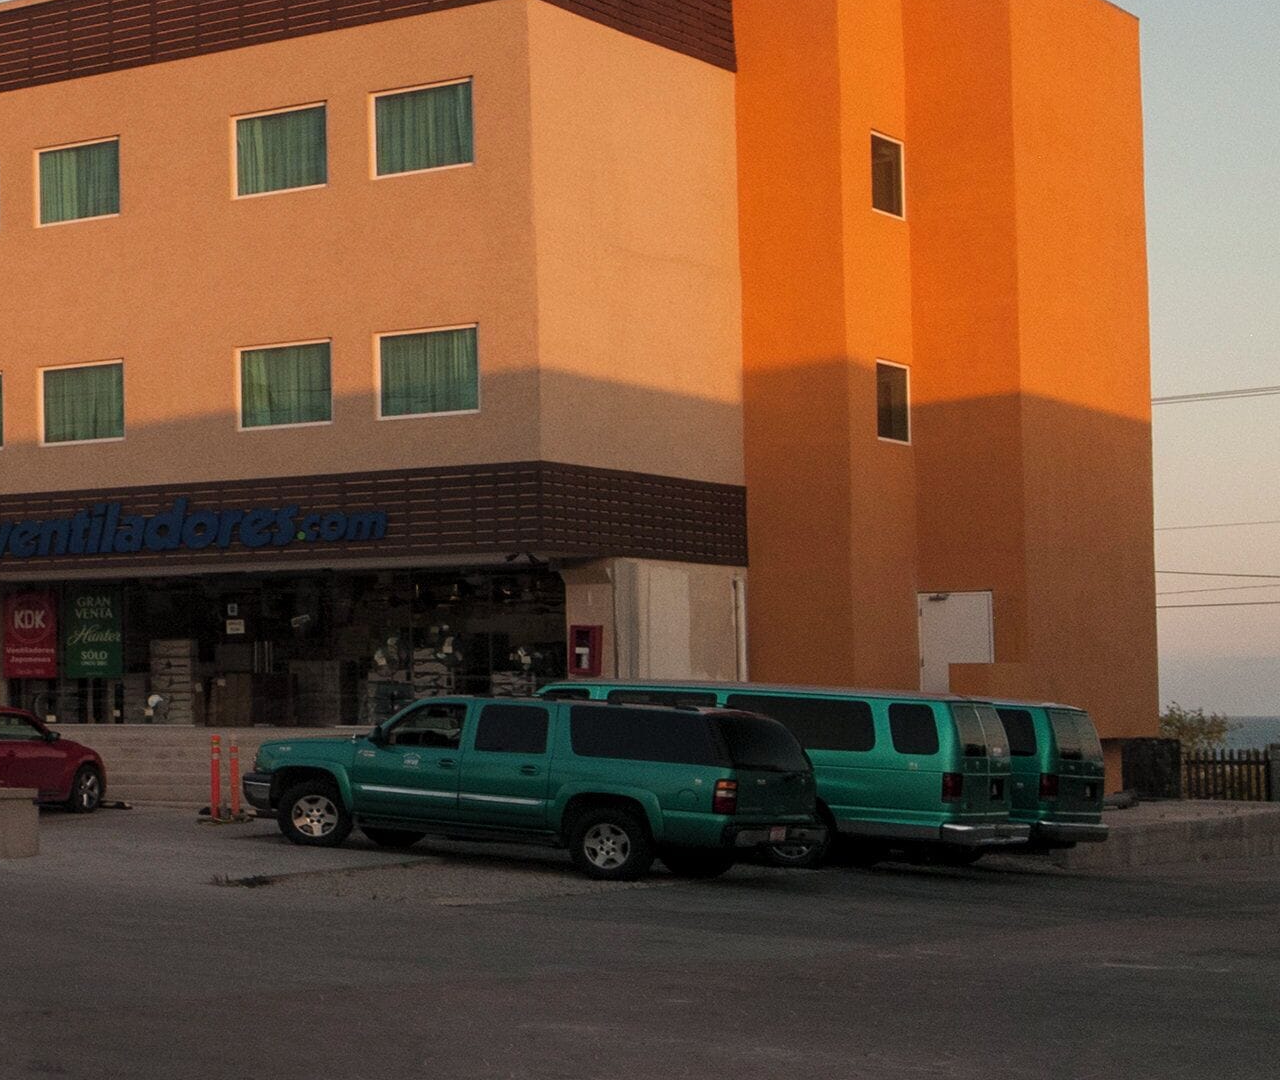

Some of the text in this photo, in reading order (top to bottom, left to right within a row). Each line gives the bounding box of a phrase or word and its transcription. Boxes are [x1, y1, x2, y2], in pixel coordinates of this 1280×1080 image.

[76, 596, 112, 608] GRAN
[14, 609, 46, 629] KDK
[75, 607, 113, 619] VENTA
[66, 624, 121, 646] Hunter
